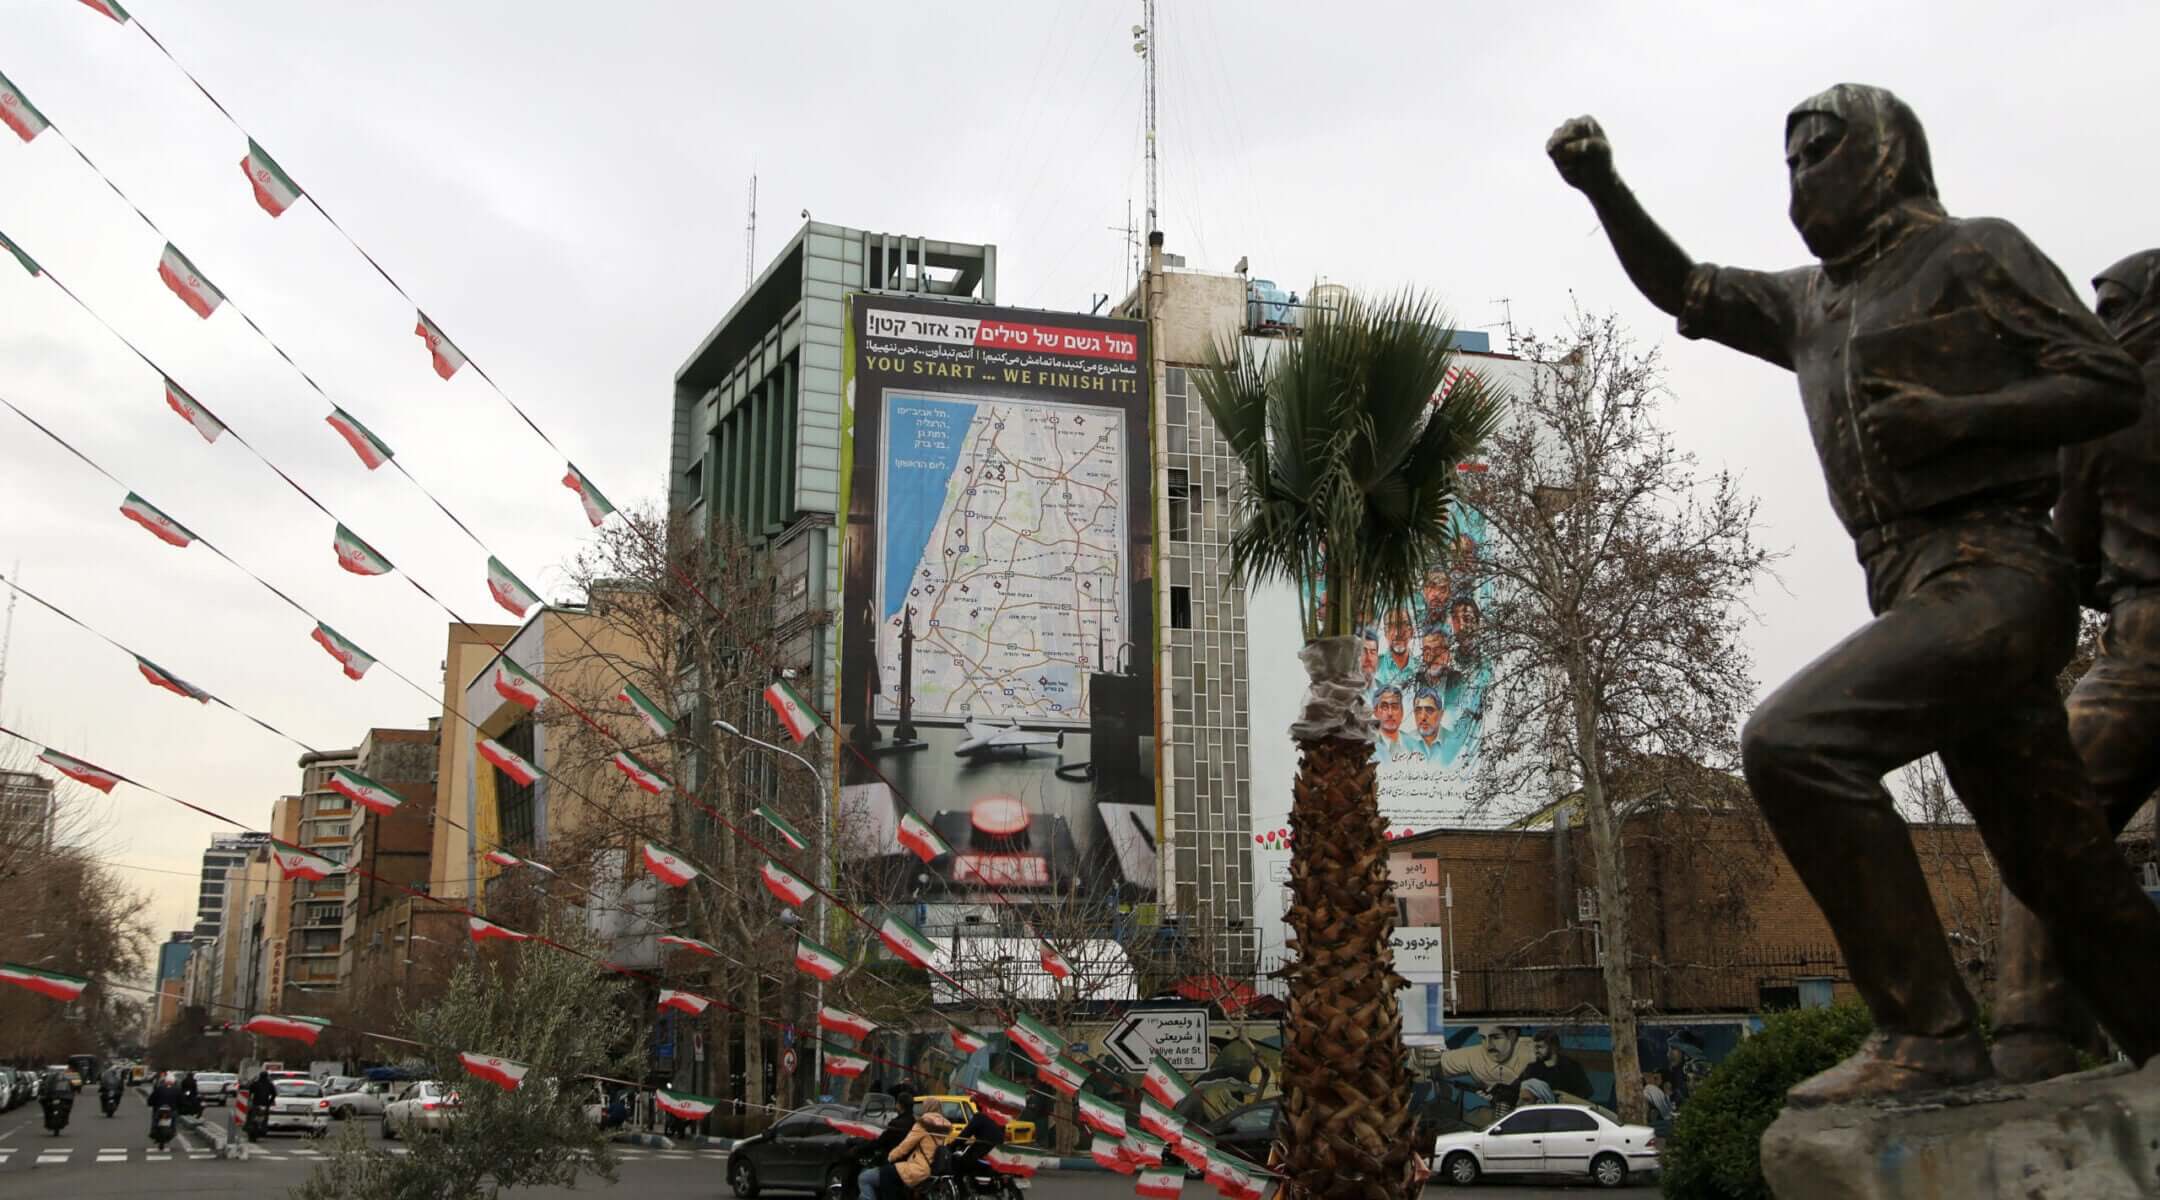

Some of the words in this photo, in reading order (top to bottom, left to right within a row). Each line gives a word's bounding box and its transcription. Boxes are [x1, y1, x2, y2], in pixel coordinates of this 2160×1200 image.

[869, 315, 906, 336] קטן!
[911, 321, 949, 337] אזור
[954, 325, 977, 339] זה
[981, 325, 1028, 345] טילים
[1033, 328, 1059, 346] של
[1063, 335, 1103, 352] גשם
[1105, 334, 1134, 354] מול
[865, 356, 905, 373] YOU
[913, 360, 975, 378] START
[1003, 368, 1032, 384] WE
[1038, 372, 1104, 392] FINISH
[1111, 379, 1137, 394] IT!
[1404, 936, 1439, 950] مزدور
[1155, 1031, 1193, 1044] شریعتی
